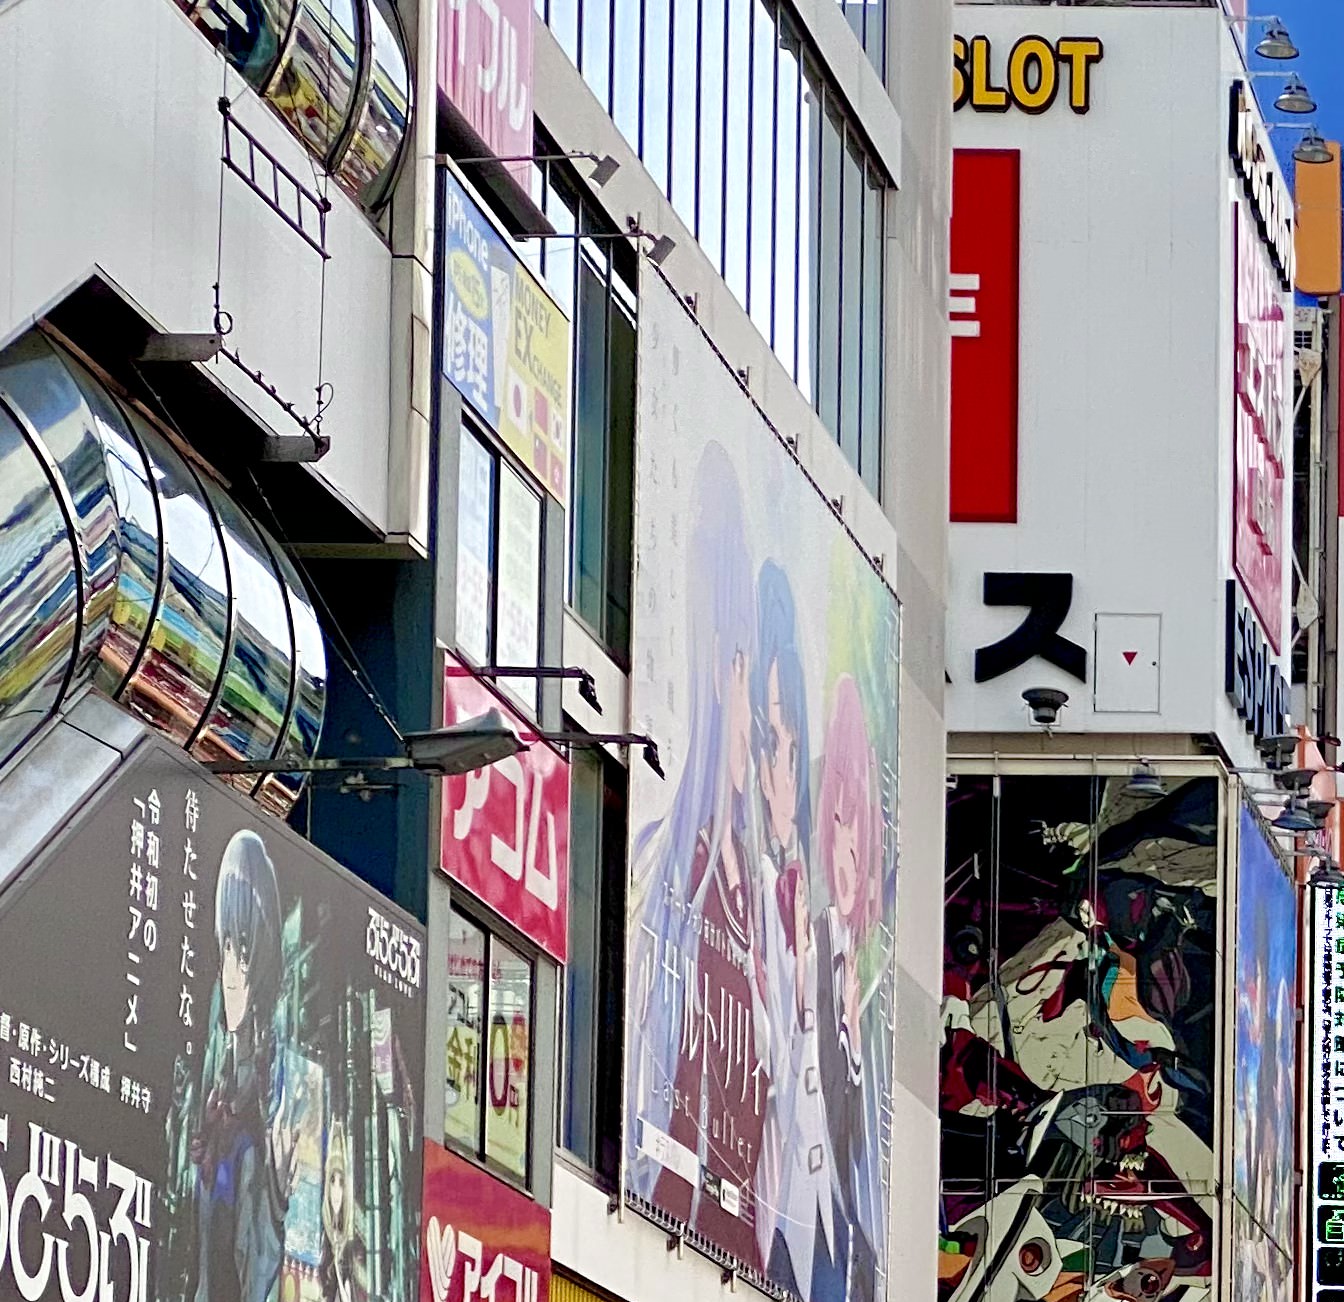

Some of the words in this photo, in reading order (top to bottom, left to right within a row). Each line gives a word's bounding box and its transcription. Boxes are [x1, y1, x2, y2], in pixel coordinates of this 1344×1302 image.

[516, 270, 551, 339] MONEY
[144, 788, 162, 952] 令和初の
